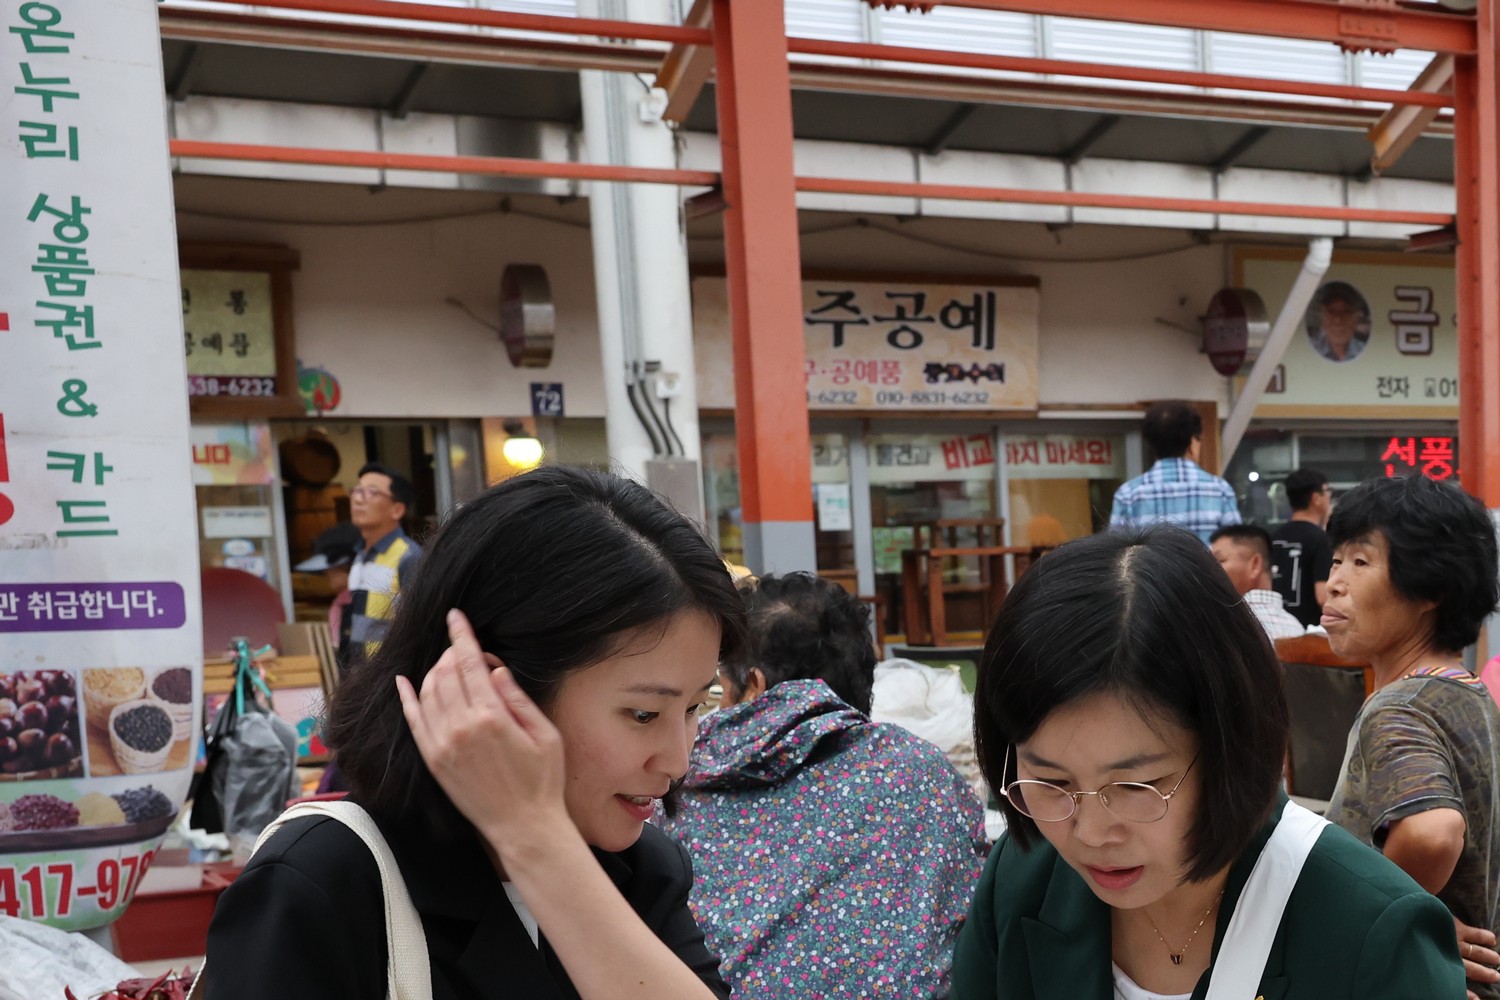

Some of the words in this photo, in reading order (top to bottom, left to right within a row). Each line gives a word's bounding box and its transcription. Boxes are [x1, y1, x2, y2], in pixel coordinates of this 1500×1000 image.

[9, 2, 80, 162] 온누리
[27, 192, 103, 352] 상품권
[805, 290, 997, 350] 주공예
[1389, 286, 1458, 356] 금
[56, 378, 99, 418] &
[535, 390, 562, 412] 72
[806, 389, 857, 404] -6232
[1376, 376, 1410, 399] 전자
[940, 433, 995, 470] 비교
[1381, 436, 1462, 481] 선풍
[46, 449, 118, 538] 카드
[27, 589, 164, 620] 취급합니다.
